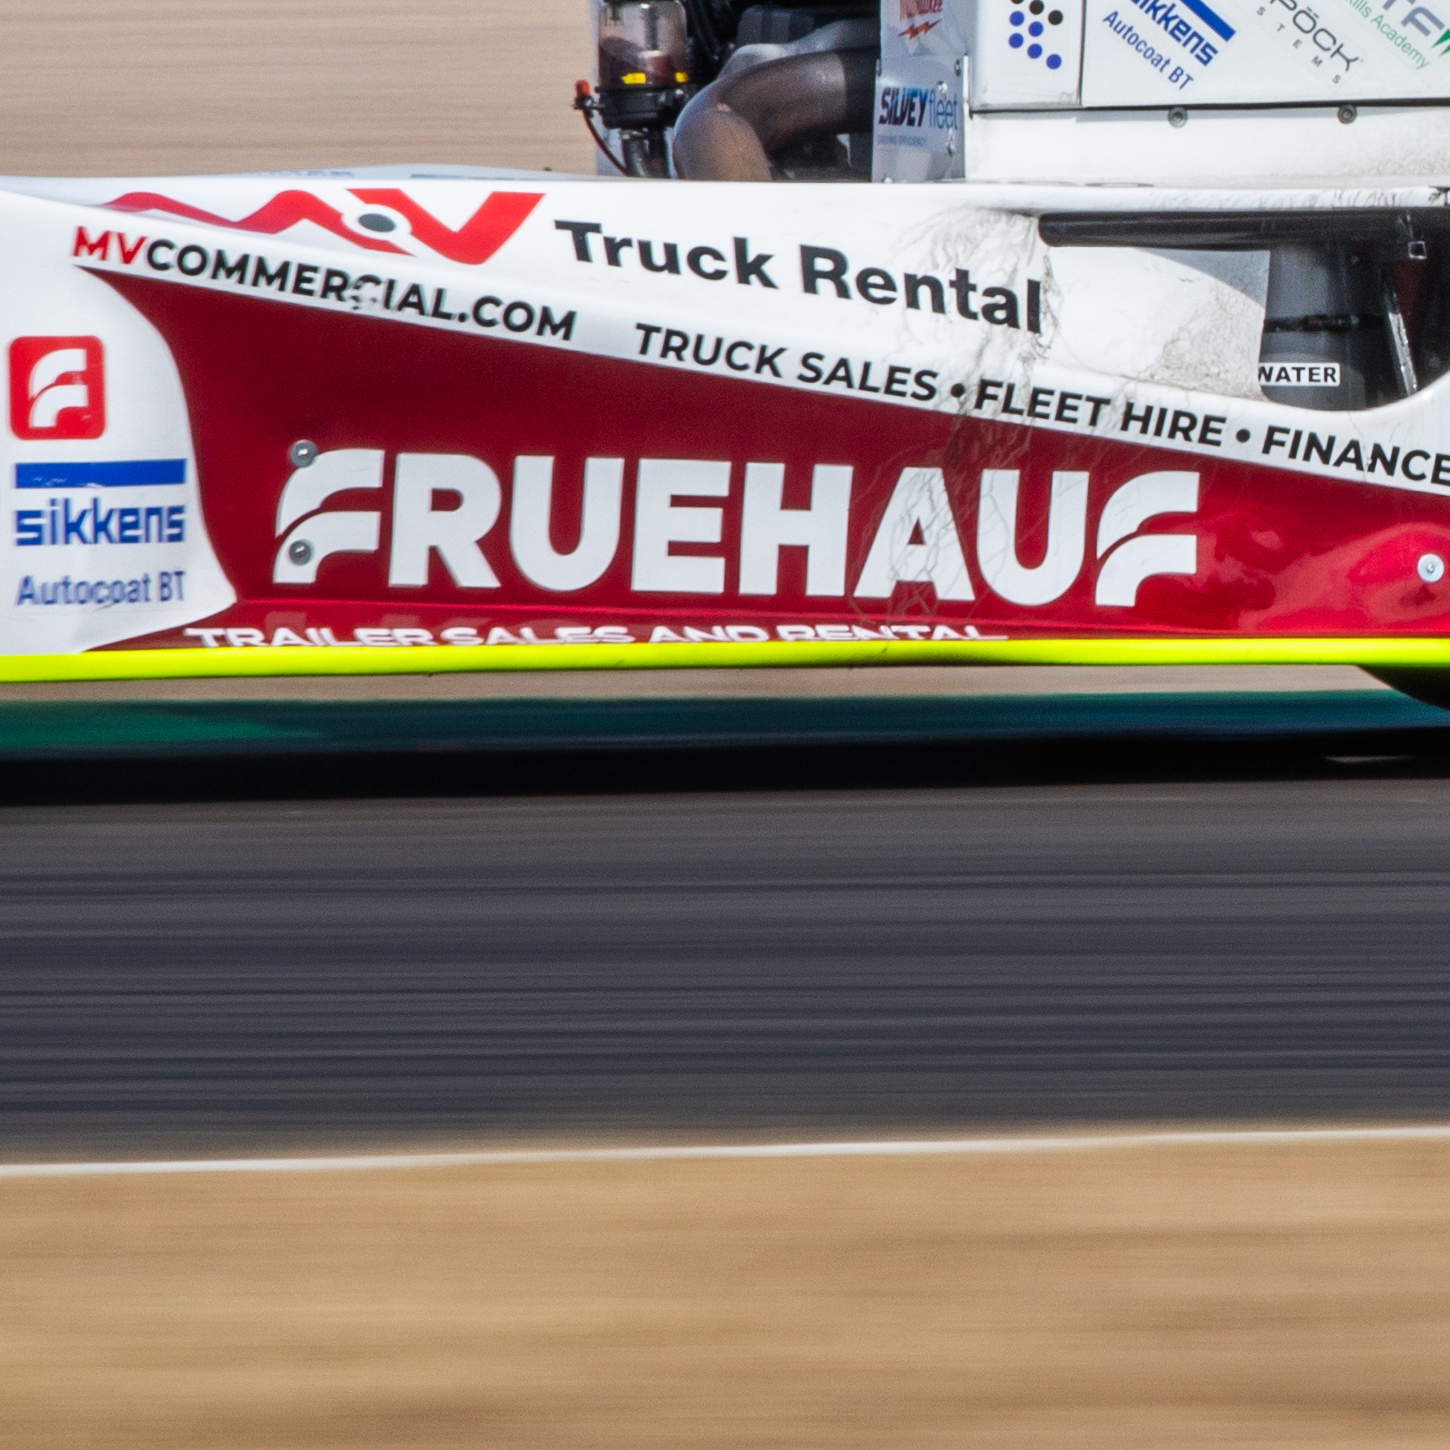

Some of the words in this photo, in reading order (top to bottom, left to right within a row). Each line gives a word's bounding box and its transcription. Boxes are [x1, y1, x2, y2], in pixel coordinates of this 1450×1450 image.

[1103, 10, 1171, 73] Autocoat
[1167, 66, 1194, 91] BT
[1371, 13, 1430, 70] Academy
[102, 188, 547, 265] MV
[554, 220, 778, 290] Truck
[800, 243, 1042, 333] Rental
[635, 323, 787, 378] TRUCK
[798, 352, 938, 402] SALES
[975, 379, 1110, 426] FLEET
[1121, 401, 1227, 448] HIRE
[1258, 365, 1338, 384] WATER
[15, 498, 185, 546] sikkens
[273, 448, 1201, 608] FRUEHAUF
[16, 574, 150, 607] Autocoat
[161, 571, 187, 602] BT
[184, 627, 436, 648] TRAILER
[440, 626, 636, 646] SALES
[649, 626, 770, 643] AND
[777, 625, 1009, 642] RENTAL
